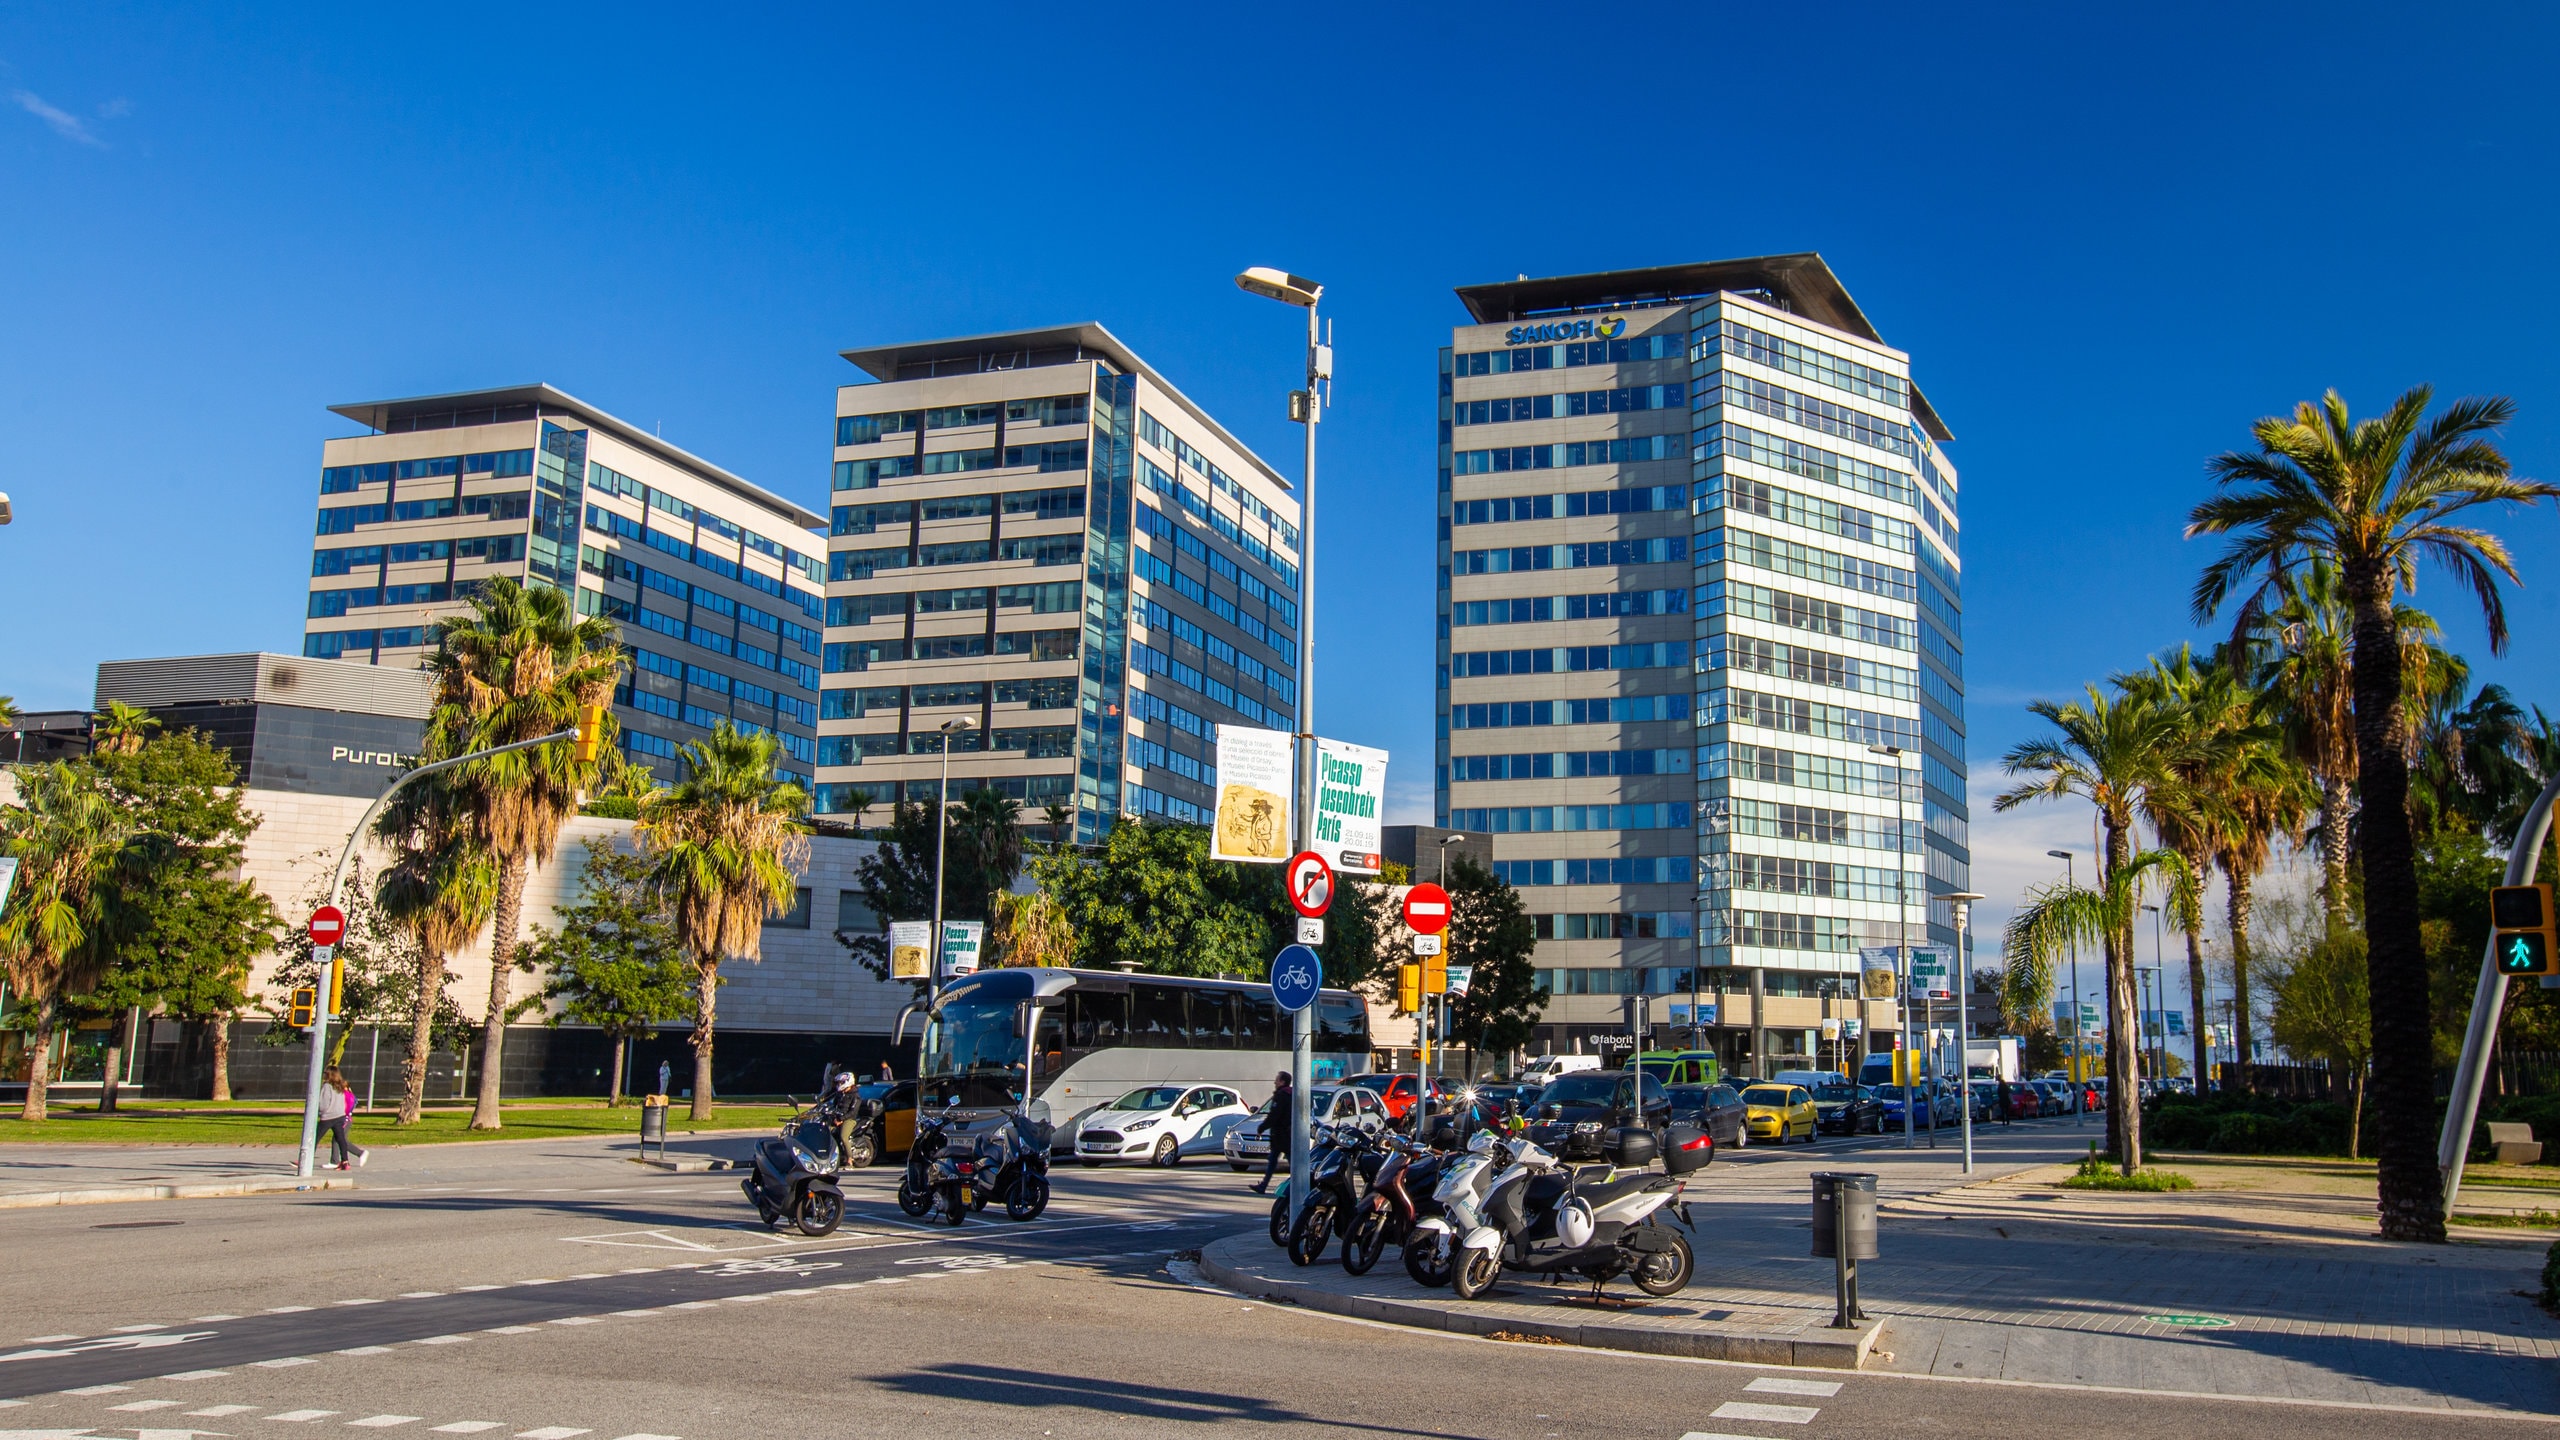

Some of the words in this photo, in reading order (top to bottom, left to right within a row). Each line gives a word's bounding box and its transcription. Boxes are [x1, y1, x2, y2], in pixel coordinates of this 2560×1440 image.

[1511, 319, 1595, 344] SANOFI
[332, 746, 427, 767] Purob
[1321, 752, 1363, 787] Picasso
[1319, 781, 1376, 819] descobreix
[1315, 811, 1342, 843] París
[1599, 1034, 1633, 1044] faborit
